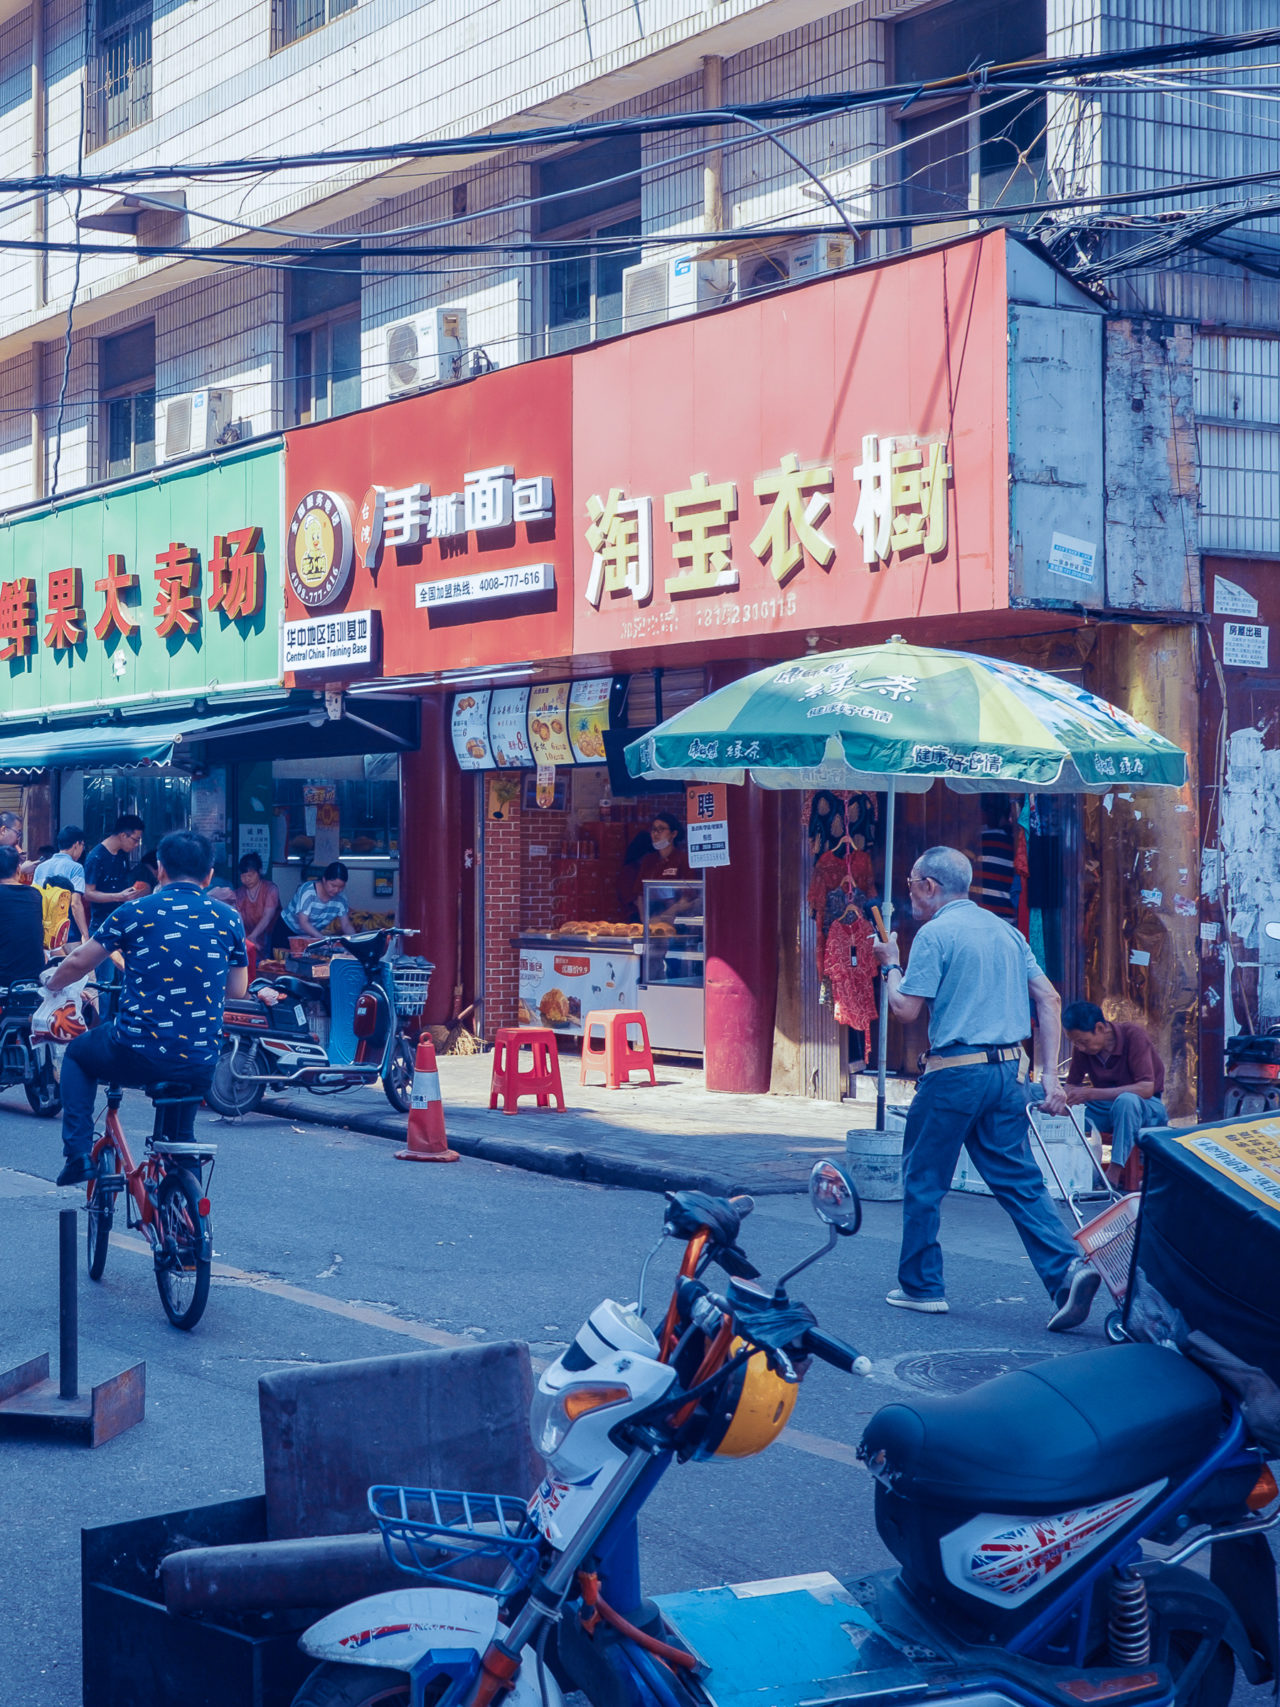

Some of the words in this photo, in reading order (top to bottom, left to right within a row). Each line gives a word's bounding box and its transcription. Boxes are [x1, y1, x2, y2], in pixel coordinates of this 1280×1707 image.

[383, 464, 553, 547] 手撕面包
[584, 433, 954, 607] 淘宝衣橱
[360, 502, 371, 545] 台湾
[290, 566, 340, 603] 4008-777-616
[479, 571, 541, 592] 4008-777-616
[287, 617, 368, 649] 华中地区培训基地
[286, 649, 308, 663] Central
[308, 647, 325, 660] China
[326, 644, 351, 658] Training
[352, 642, 367, 655] Base
[913, 744, 1003, 774] 健康好心情
[697, 792, 715, 819] 聘
